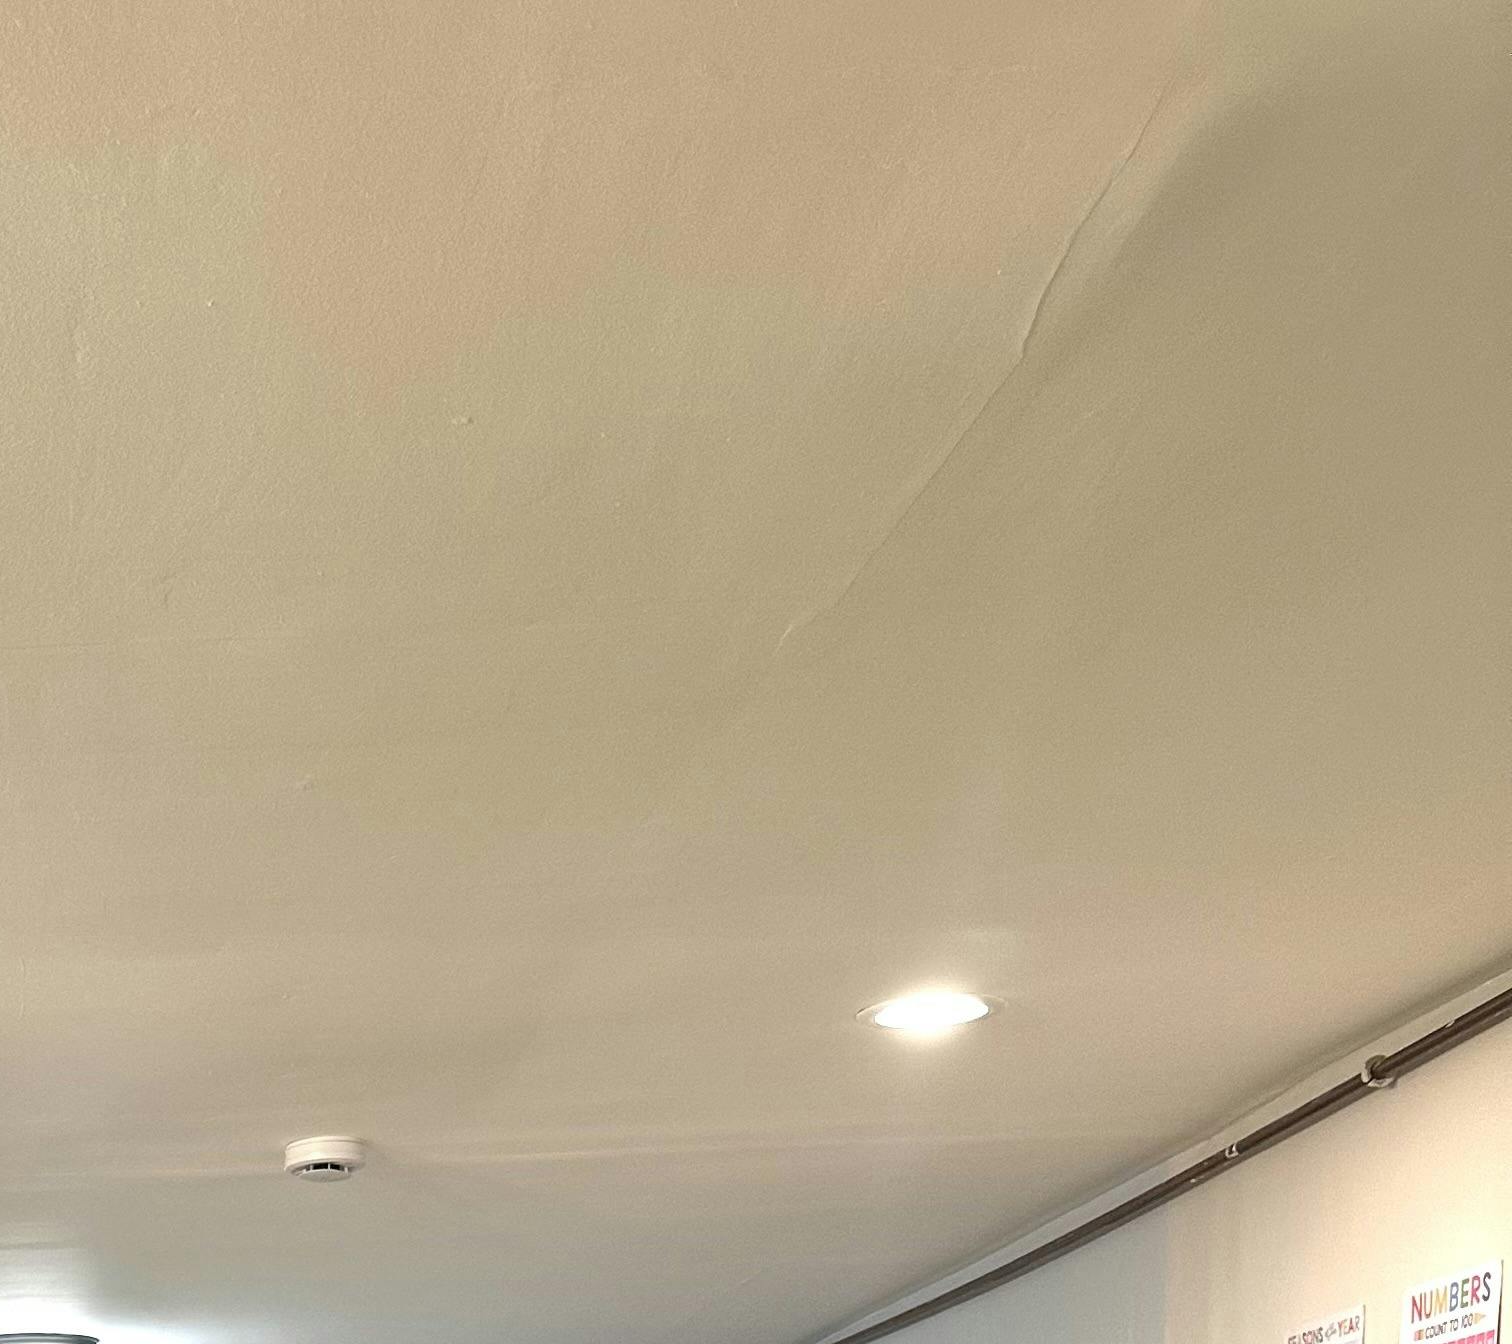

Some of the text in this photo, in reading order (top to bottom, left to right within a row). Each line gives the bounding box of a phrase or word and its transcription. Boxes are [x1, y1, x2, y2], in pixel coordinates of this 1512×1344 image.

[1411, 1272, 1492, 1324] NUMBERS
[1338, 1315, 1360, 1337] YEAR
[1425, 1313, 1474, 1339] COUNT TO 100
